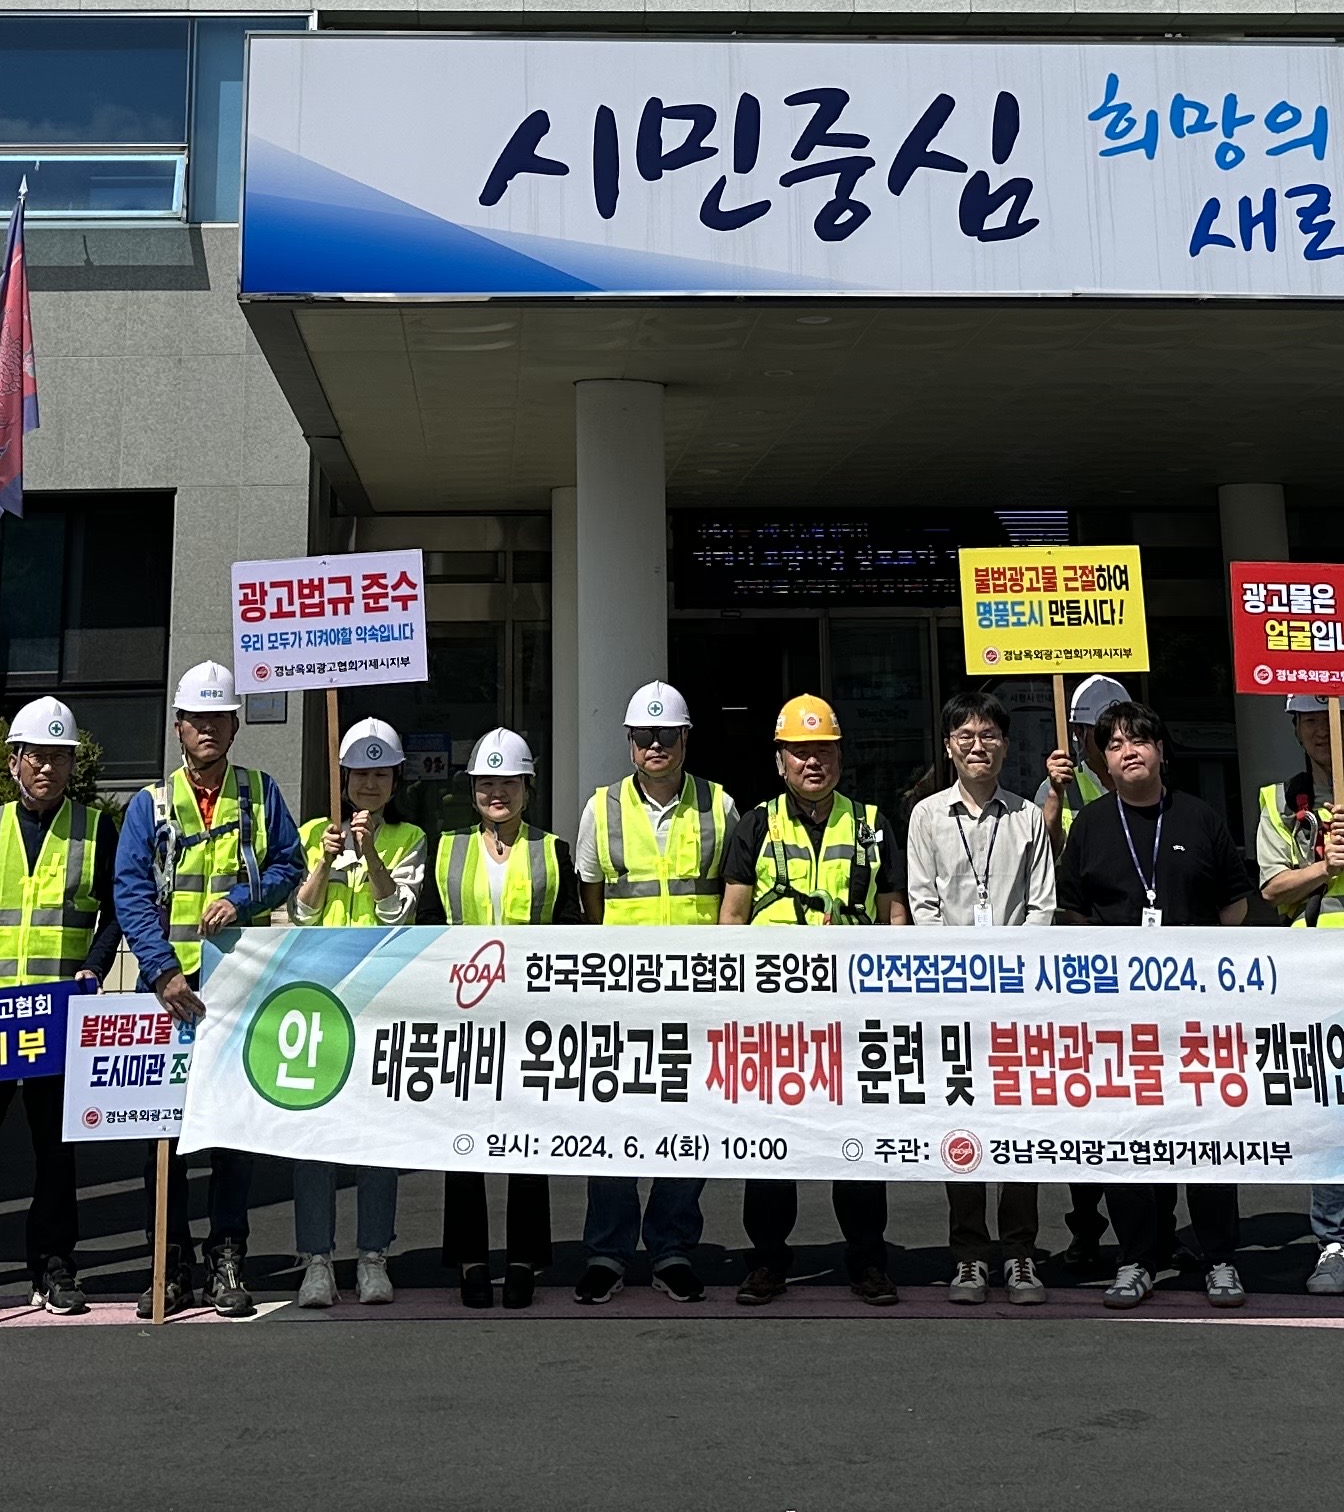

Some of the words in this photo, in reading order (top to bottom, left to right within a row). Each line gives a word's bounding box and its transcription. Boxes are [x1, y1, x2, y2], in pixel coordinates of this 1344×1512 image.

[479, 88, 1039, 242] 시민중심
[1088, 74, 1328, 170] 희망의
[974, 566, 1058, 594] 불법광고물
[1063, 564, 1130, 593] 근절하여
[238, 574, 354, 623] 광고법규
[361, 570, 418, 613] 준수
[1242, 583, 1336, 615] 광고물은
[976, 599, 1044, 629] 명품도시
[240, 633, 264, 653] 우리
[267, 630, 303, 650] 모두가
[305, 626, 353, 648] 지켜야할
[355, 622, 414, 643] 약속입니다
[449, 963, 506, 983] KOAA
[526, 952, 744, 994] 한국옥외광고협회
[756, 954, 837, 993] 중앙회
[848, 953, 1027, 995] (안전점검의날
[1040, 955, 1117, 993] 시행일
[1130, 955, 1206, 992] 2024.
[1218, 955, 1278, 995] 6.4)
[80, 1013, 172, 1048] 불법광고물
[276, 1010, 323, 1089] 안
[372, 1021, 505, 1101] 태풍대비
[521, 1021, 691, 1102] 옥외광고물
[706, 1021, 844, 1105] 재해방재
[858, 1020, 925, 1104] 훈련
[941, 1022, 974, 1105] 및
[988, 1021, 1164, 1107] 불법광고물
[1179, 1020, 1249, 1106] 추방
[89, 1053, 166, 1088] 도시미관
[485, 1133, 539, 1159] 일시:
[551, 1136, 612, 1158] 2024.
[625, 1136, 644, 1158] 6.
[655, 1132, 710, 1162] 4(화)
[722, 1138, 787, 1159] 10:00
[875, 1139, 929, 1163] 주관:
[990, 1140, 1292, 1165] 경남옥외광고협회거제시지부
